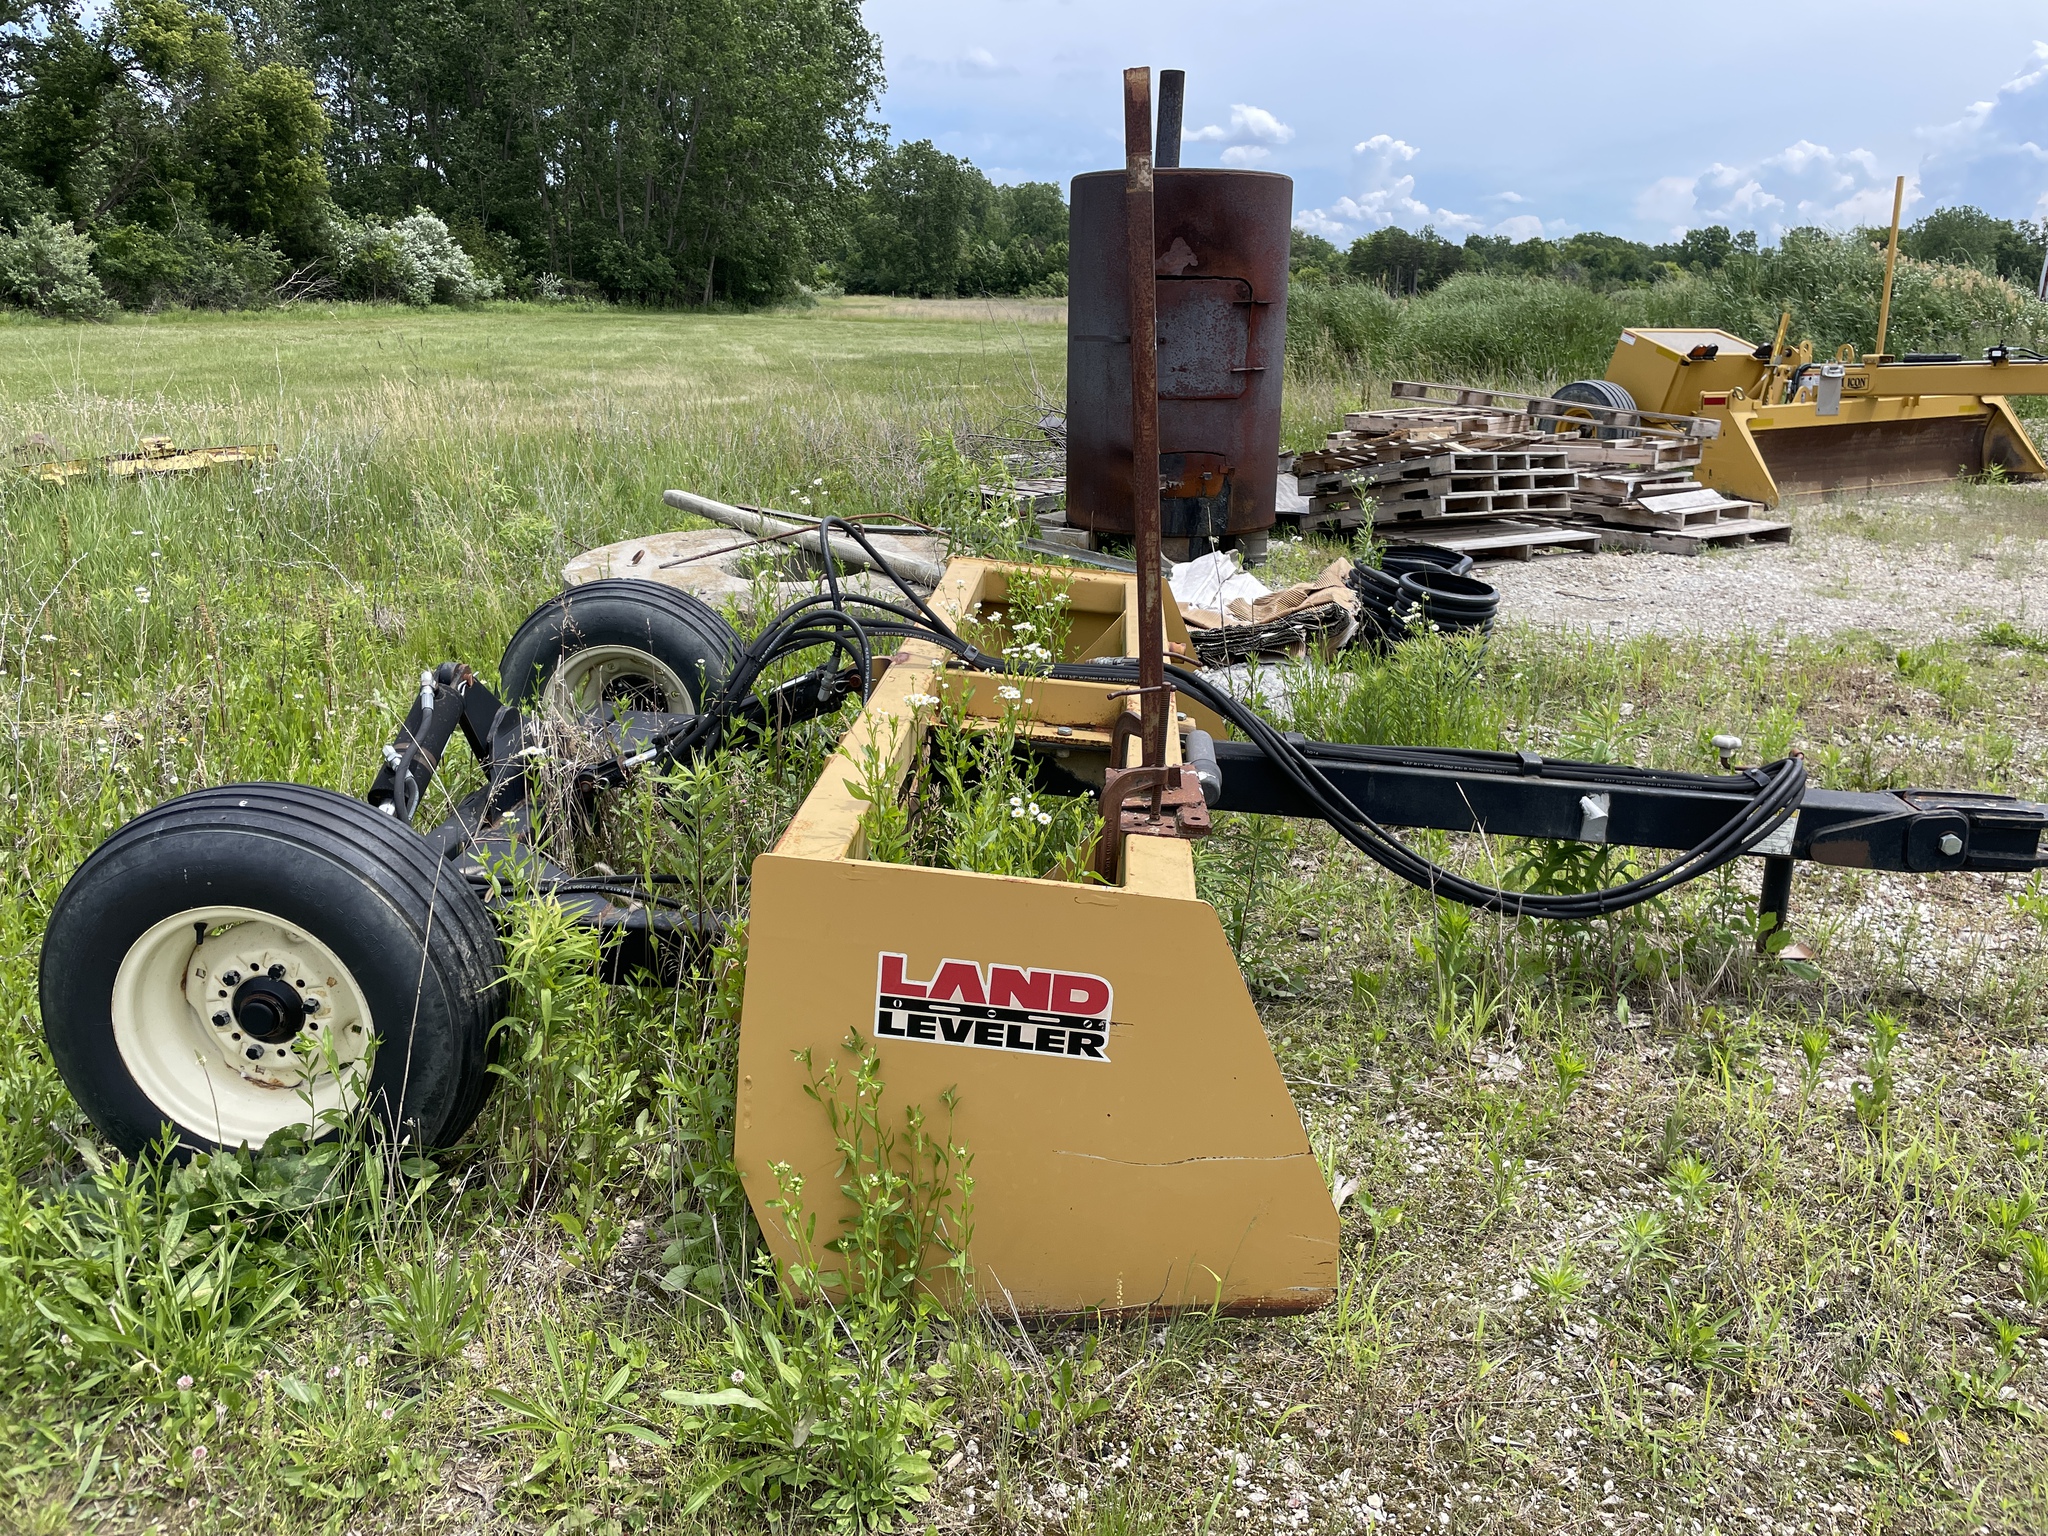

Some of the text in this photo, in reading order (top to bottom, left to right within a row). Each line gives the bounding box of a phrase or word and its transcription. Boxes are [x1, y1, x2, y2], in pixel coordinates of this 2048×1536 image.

[1847, 377, 1866, 387] ICON
[880, 955, 1110, 1016] LAND
[877, 1010, 1105, 1059] LEVELER
